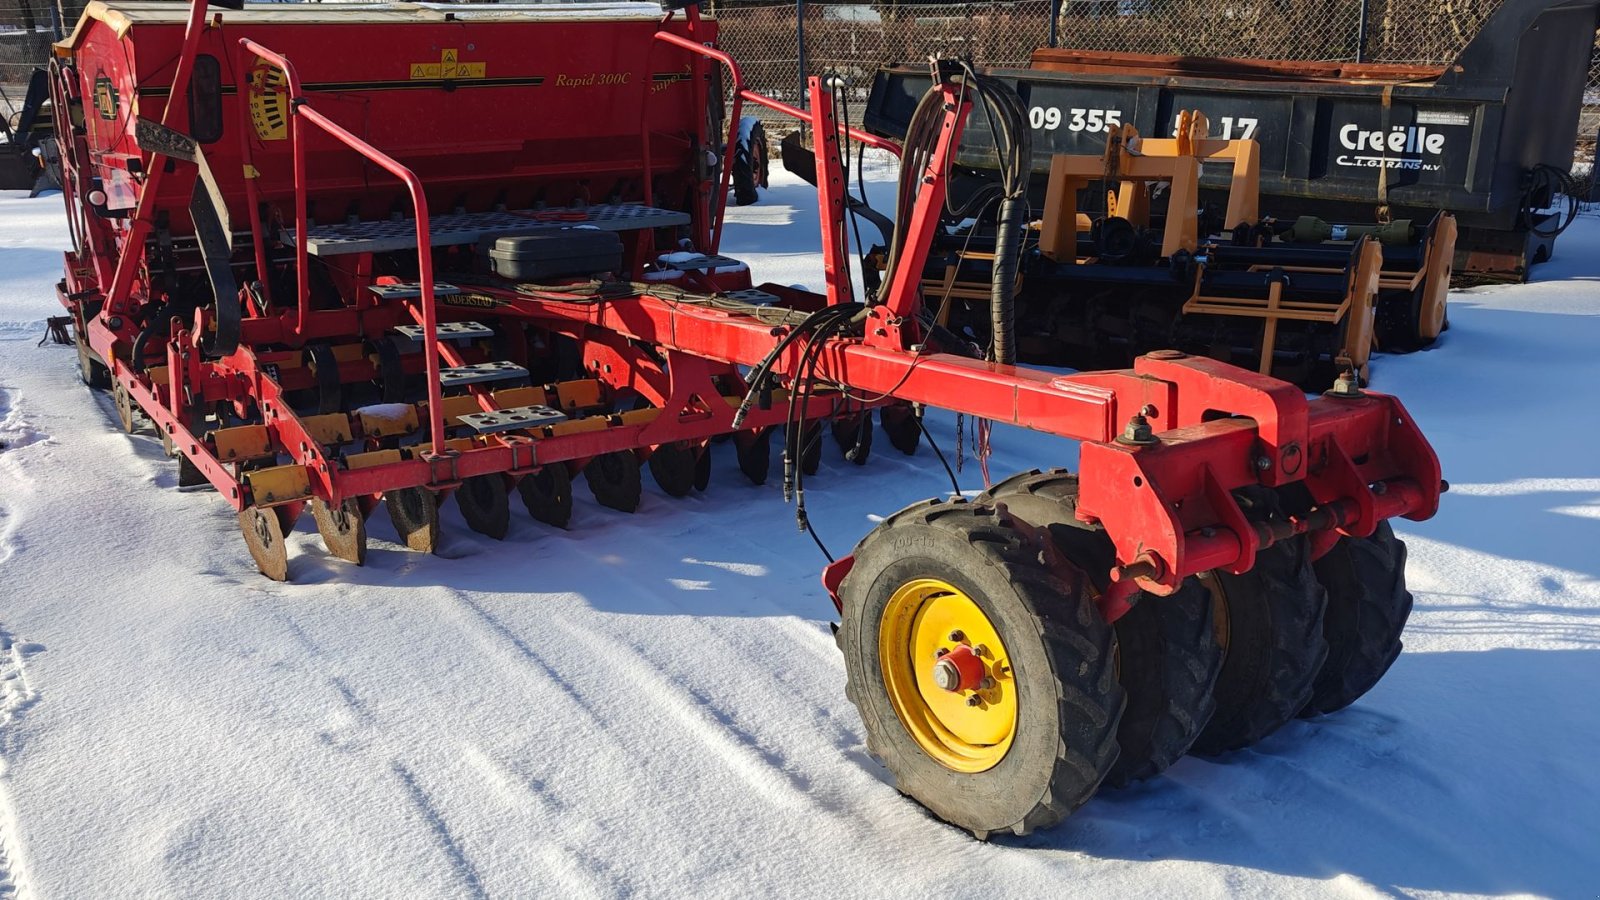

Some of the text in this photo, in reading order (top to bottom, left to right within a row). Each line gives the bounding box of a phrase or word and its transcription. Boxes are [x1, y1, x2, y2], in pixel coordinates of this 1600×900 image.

[556, 72, 631, 88] Rapid 300C
[252, 111, 261, 119] 12
[255, 121, 264, 129] 14
[1029, 106, 1061, 130] 09
[1068, 108, 1121, 133] 355
[1221, 116, 1258, 140] 17
[259, 130, 269, 138] 16
[1340, 124, 1445, 154] Creëlle
